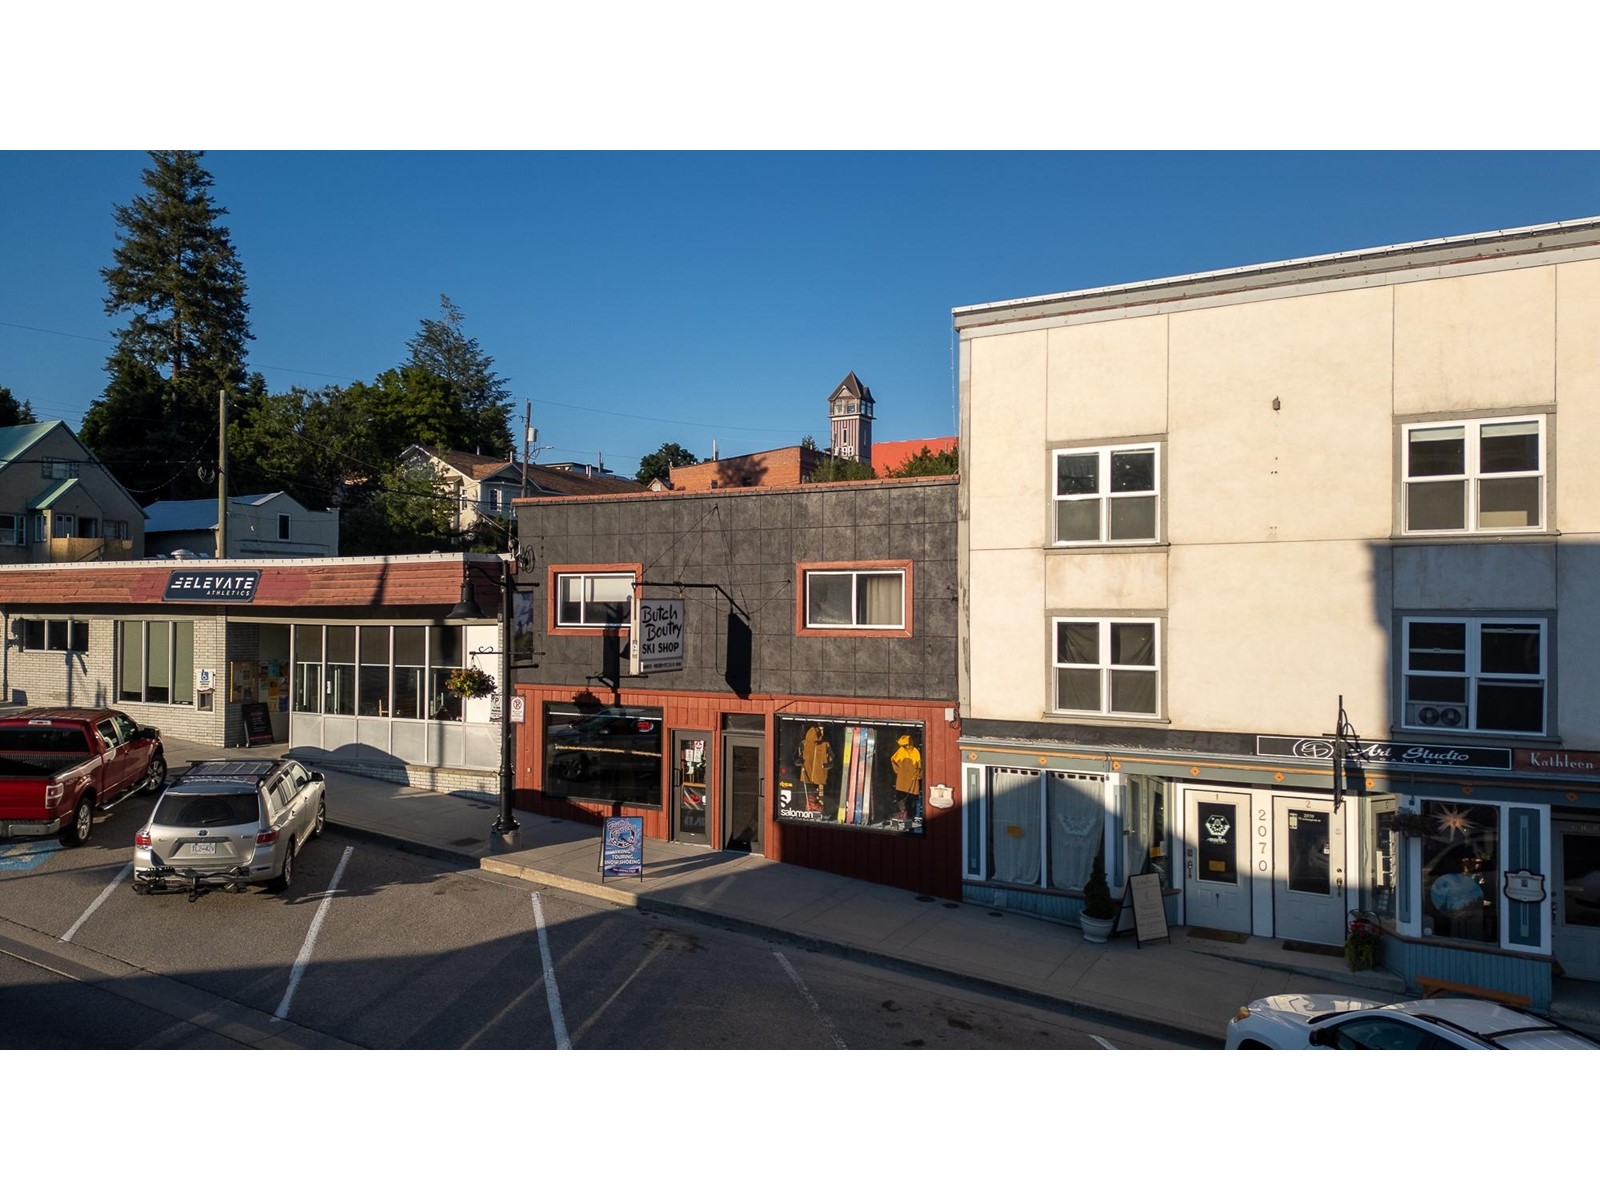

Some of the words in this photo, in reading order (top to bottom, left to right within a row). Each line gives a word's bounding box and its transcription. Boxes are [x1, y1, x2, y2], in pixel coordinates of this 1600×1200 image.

[183, 577, 255, 589] ELEVATE
[641, 604, 678, 623] Butch
[645, 621, 682, 641] Boutry
[642, 643, 655, 655] SKI
[658, 642, 680, 653] SHOP
[1402, 747, 1469, 761] Studio
[1530, 752, 1594, 769] Kathleen
[781, 807, 814, 818] salomon
[1258, 809, 1267, 872] 2070
